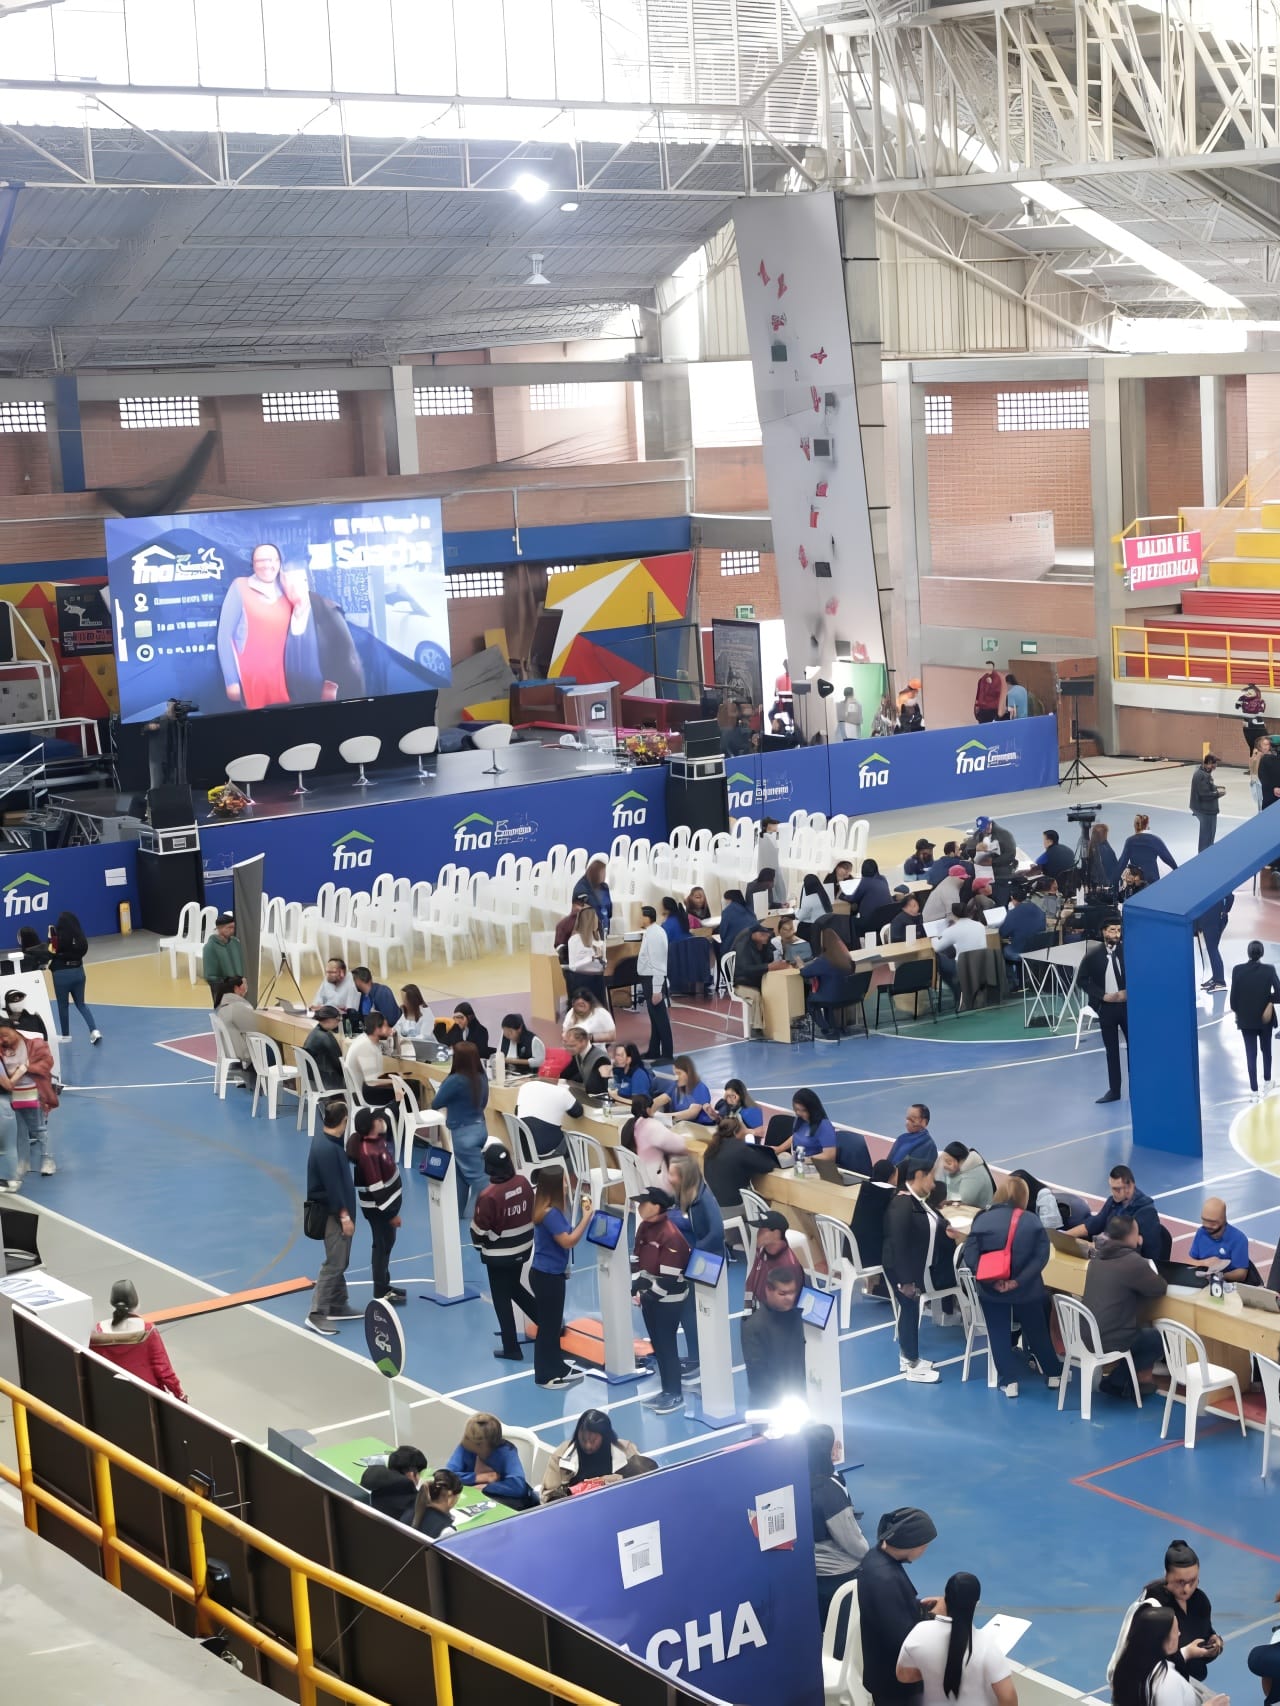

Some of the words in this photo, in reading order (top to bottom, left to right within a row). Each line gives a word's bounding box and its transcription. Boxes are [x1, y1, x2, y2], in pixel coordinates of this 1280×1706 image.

[956, 751, 986, 775] fna
[859, 765, 889, 789] fna
[727, 785, 754, 811] na
[612, 804, 647, 829] fna
[455, 826, 492, 852] fna
[333, 845, 373, 871] fna
[4, 888, 49, 917] fna
[619, 1600, 768, 1677] CHA
